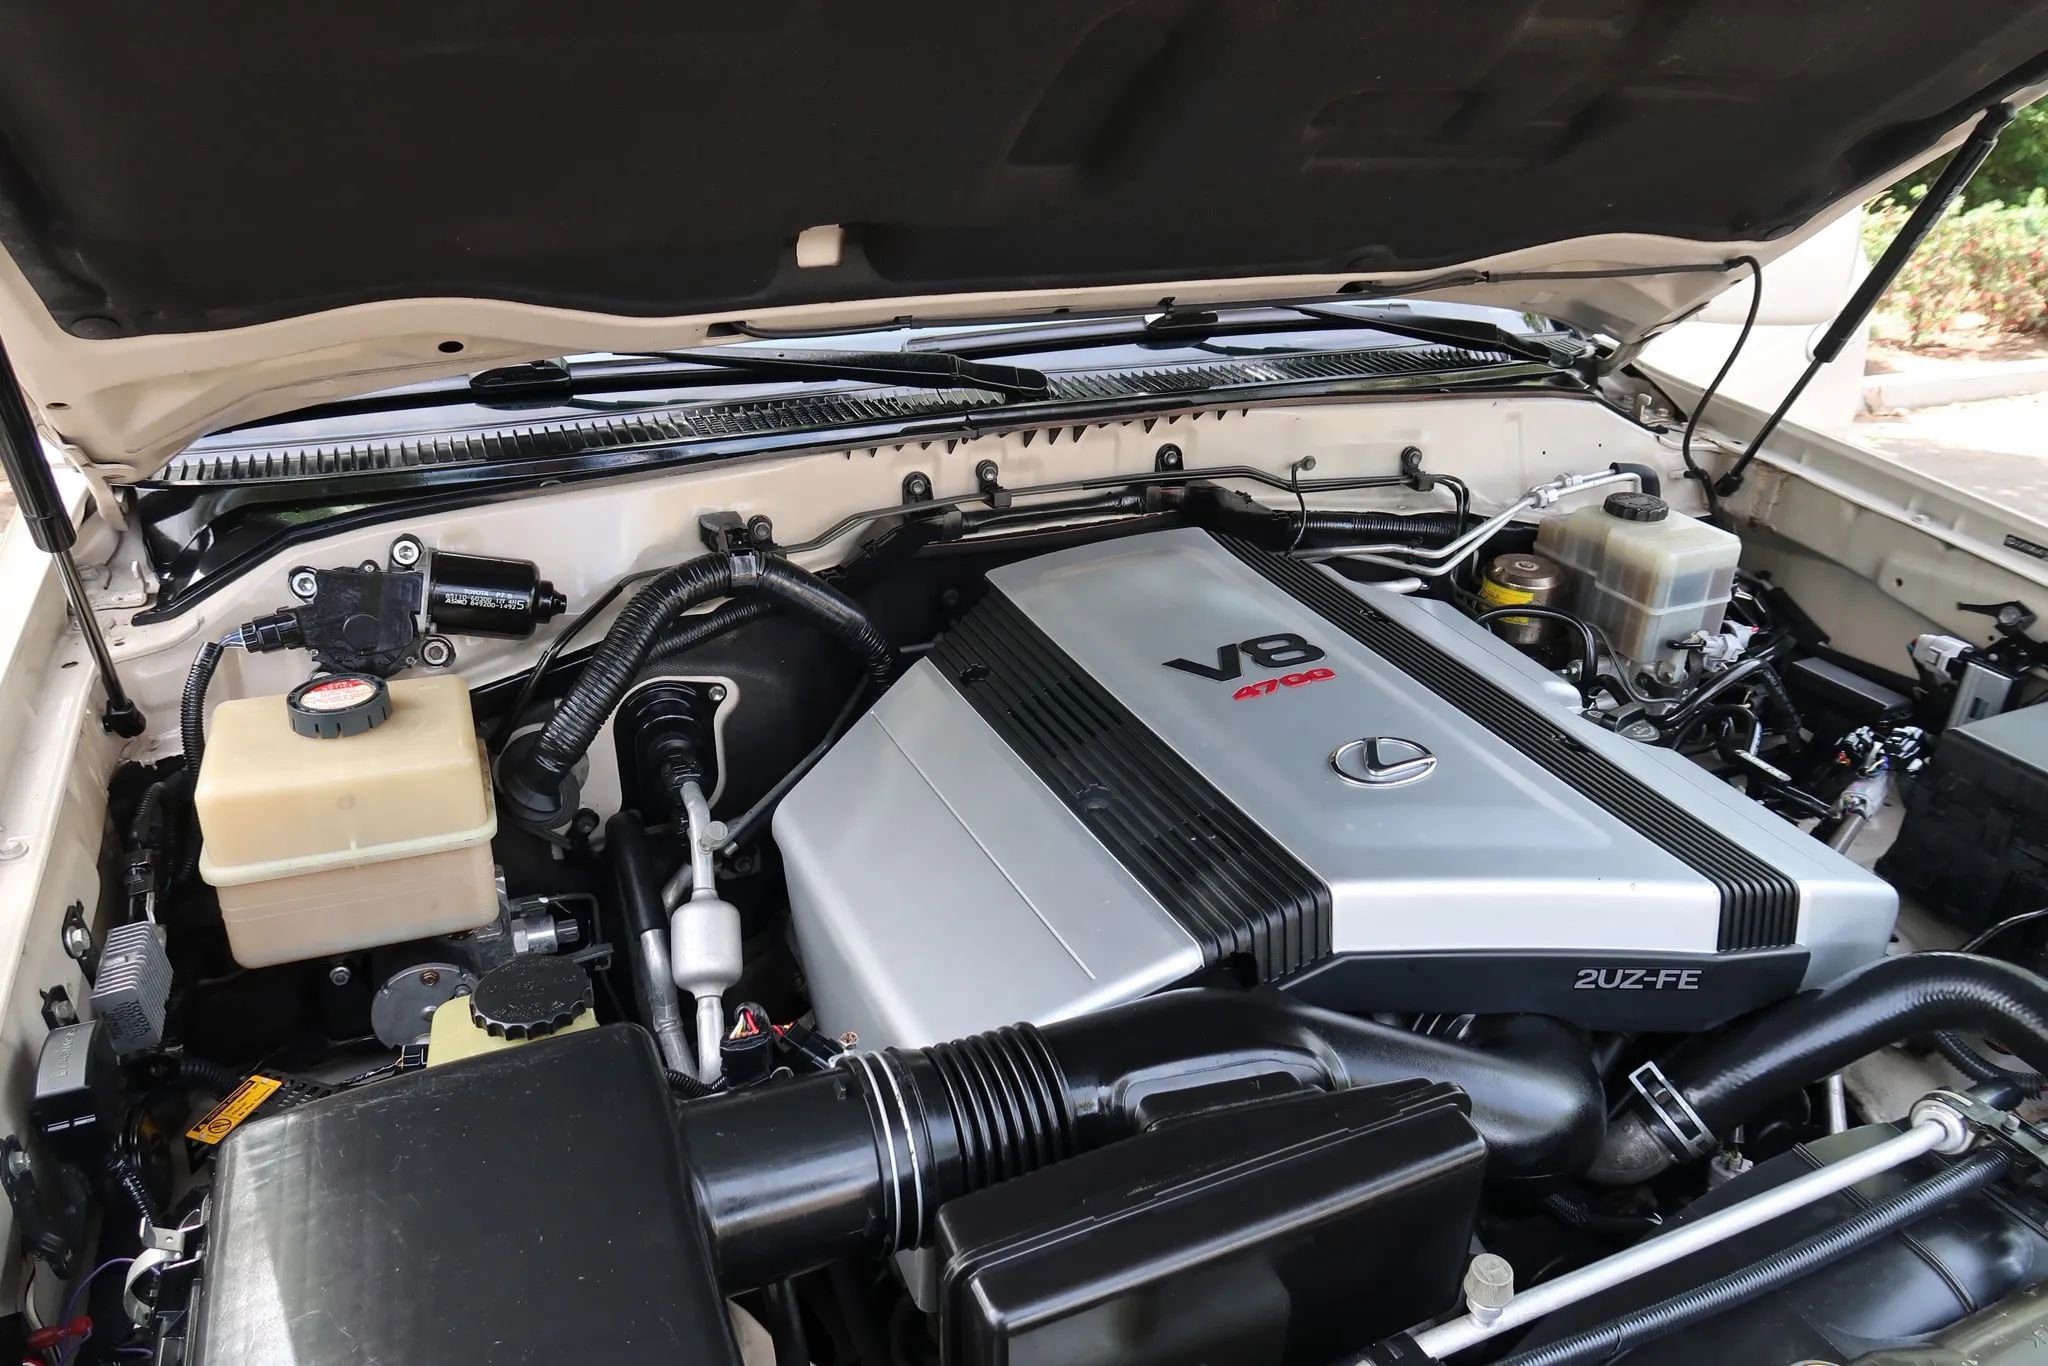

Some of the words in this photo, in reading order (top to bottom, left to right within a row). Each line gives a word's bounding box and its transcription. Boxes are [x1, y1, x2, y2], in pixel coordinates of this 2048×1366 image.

[463, 588, 489, 597] TOYOTA
[1161, 632, 1327, 682] V8
[1231, 667, 1337, 701] 4700
[1573, 968, 1703, 990] 2UZ-FE
[130, 1000, 152, 1032] TOYOTA
